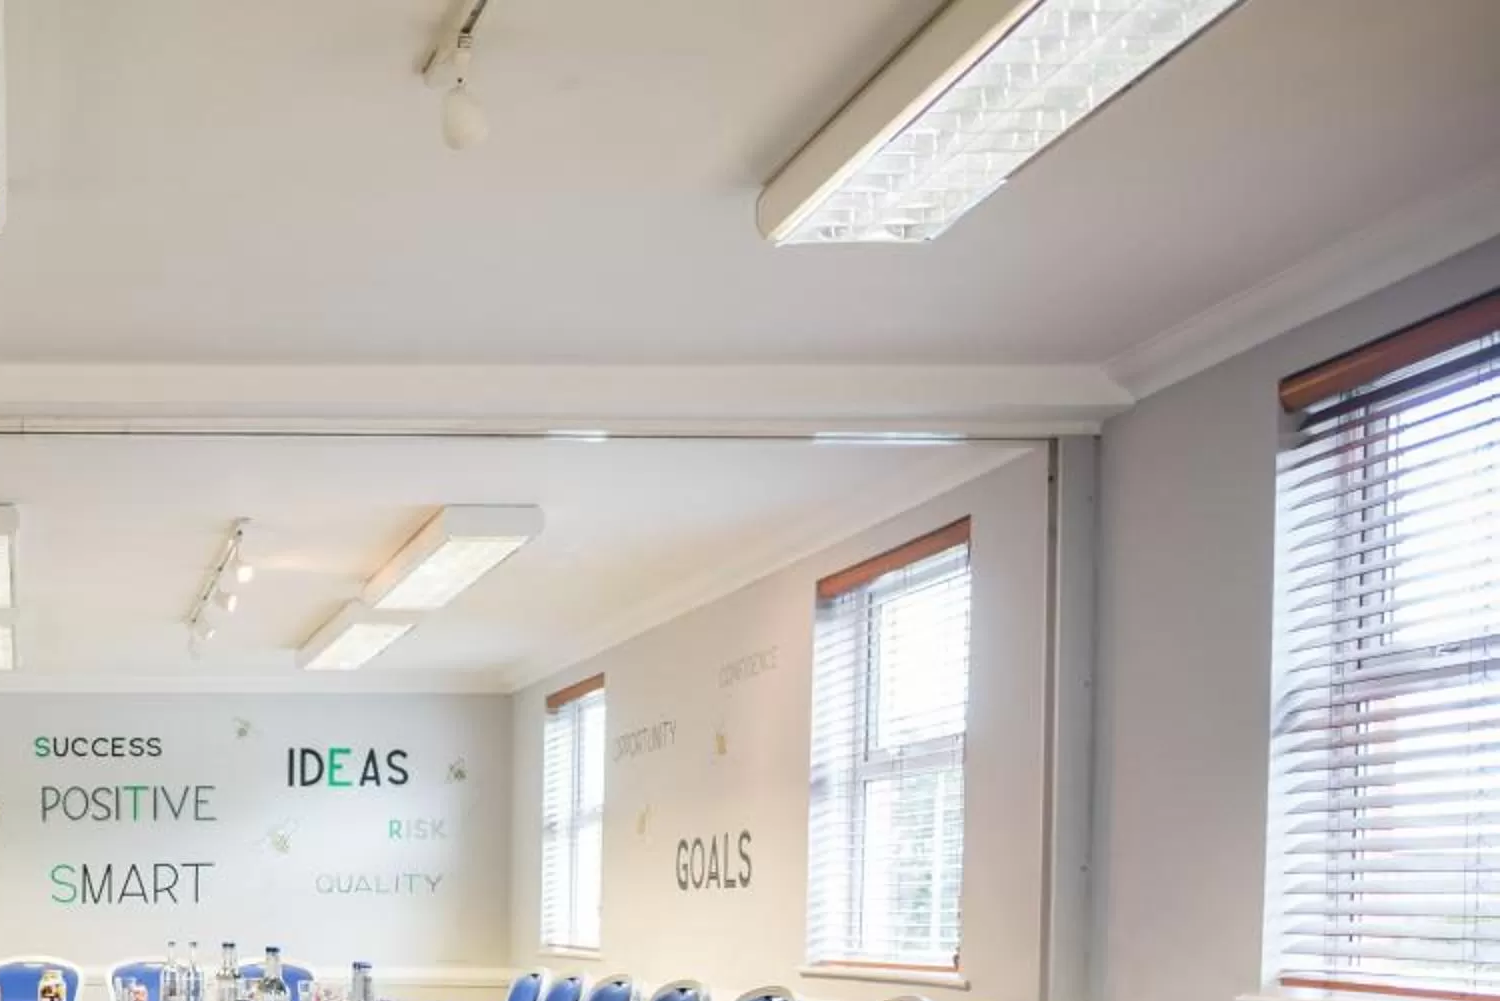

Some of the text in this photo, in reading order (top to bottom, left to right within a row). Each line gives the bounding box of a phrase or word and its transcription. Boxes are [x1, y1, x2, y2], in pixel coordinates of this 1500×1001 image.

[34, 737, 163, 758] SUCCESS
[287, 748, 409, 788] IDEAS
[40, 786, 218, 823] POSITIVE
[389, 820, 447, 840] RISK
[675, 829, 753, 891] GOALS
[50, 863, 216, 905] SMART
[315, 873, 445, 895] QUALITY
